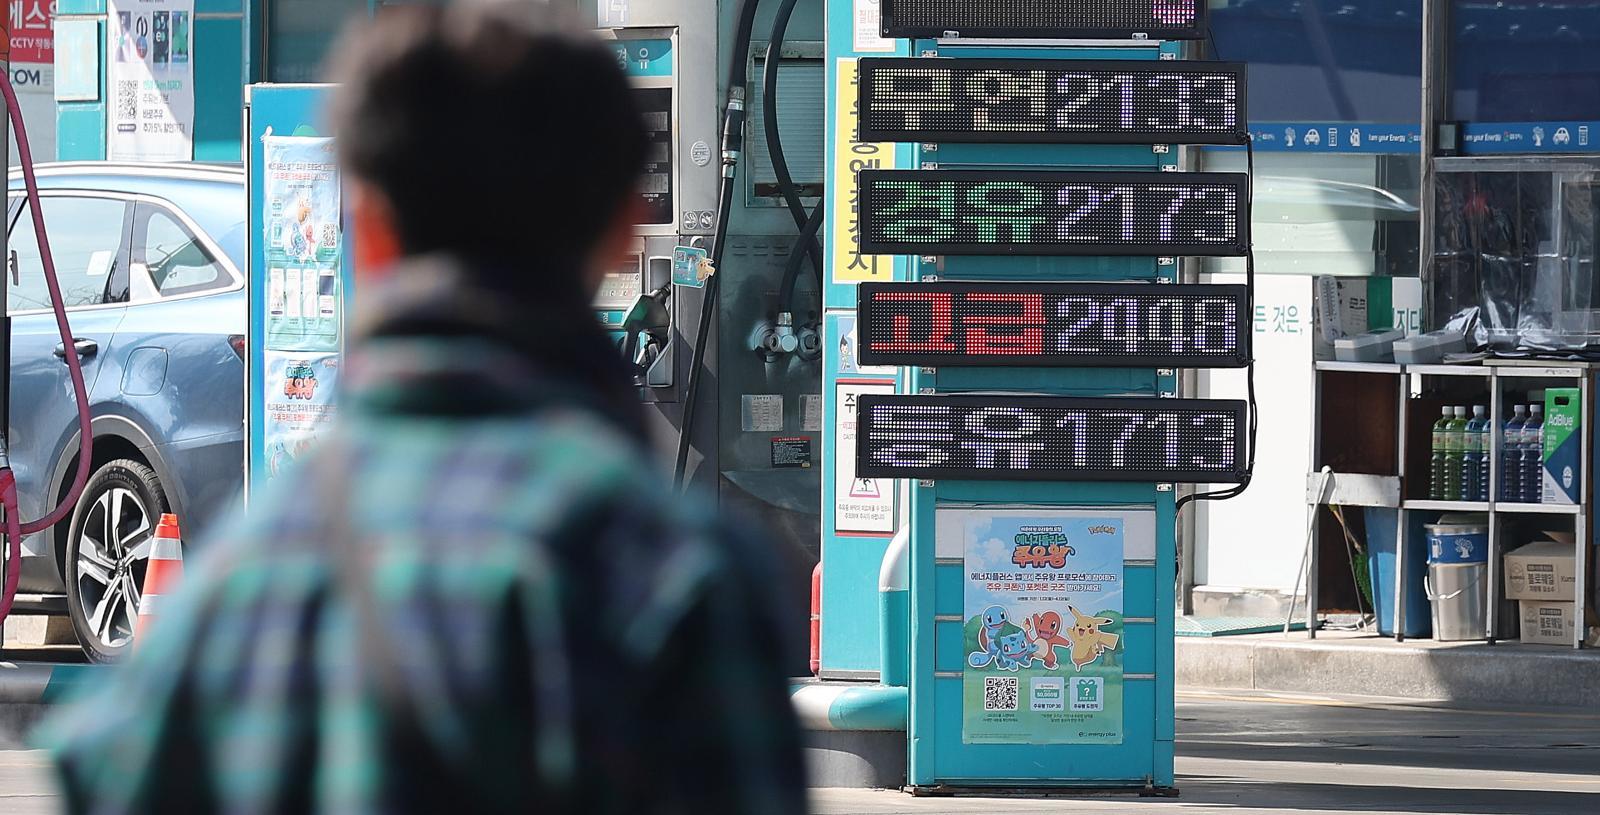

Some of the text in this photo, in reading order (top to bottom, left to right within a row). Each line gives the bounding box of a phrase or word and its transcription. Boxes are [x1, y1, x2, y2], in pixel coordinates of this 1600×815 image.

[10, 37, 34, 49] CCTV
[870, 68, 1046, 131] 무연
[1056, 74, 1236, 130] 2133
[874, 181, 1236, 243] 경유 2173
[870, 292, 1236, 355] 고급 2448
[1273, 304, 1303, 335] 것은,
[1548, 414, 1574, 426] AdBlue
[869, 406, 1235, 469] 등유 1713
[1015, 533, 1068, 547] 에너지플러스
[1012, 543, 1075, 568] 주유왕
[970, 572, 1013, 582] 에너지플러스
[1034, 572, 1056, 582] 주유왕
[986, 583, 1002, 592] 주유
[1026, 583, 1049, 592] 포켓몬
[1051, 583, 1066, 592] 굿즈
